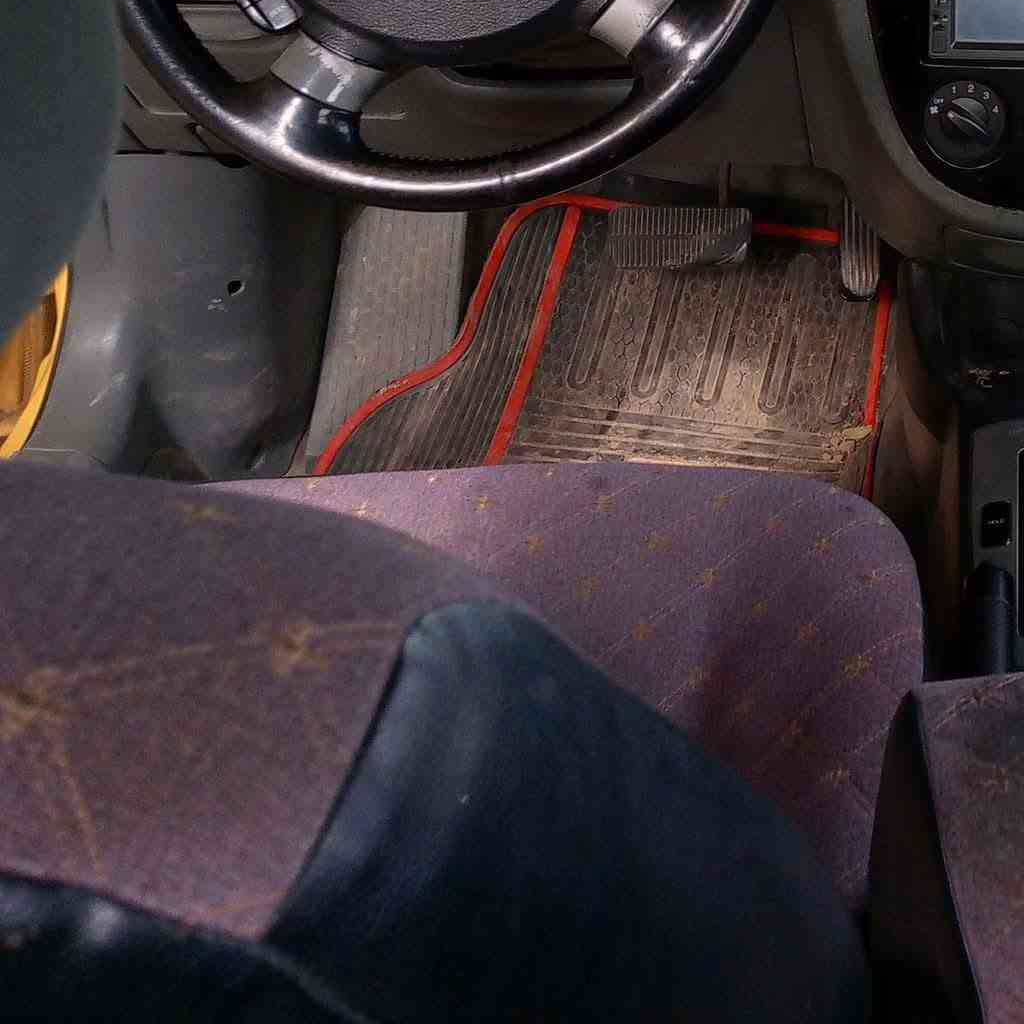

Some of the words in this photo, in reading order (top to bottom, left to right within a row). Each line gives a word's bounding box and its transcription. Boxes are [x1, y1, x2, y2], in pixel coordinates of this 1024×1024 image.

[951, 85, 957, 94] 1
[967, 83, 976, 94] 2
[983, 90, 991, 100] 3
[992, 105, 999, 113] 4
